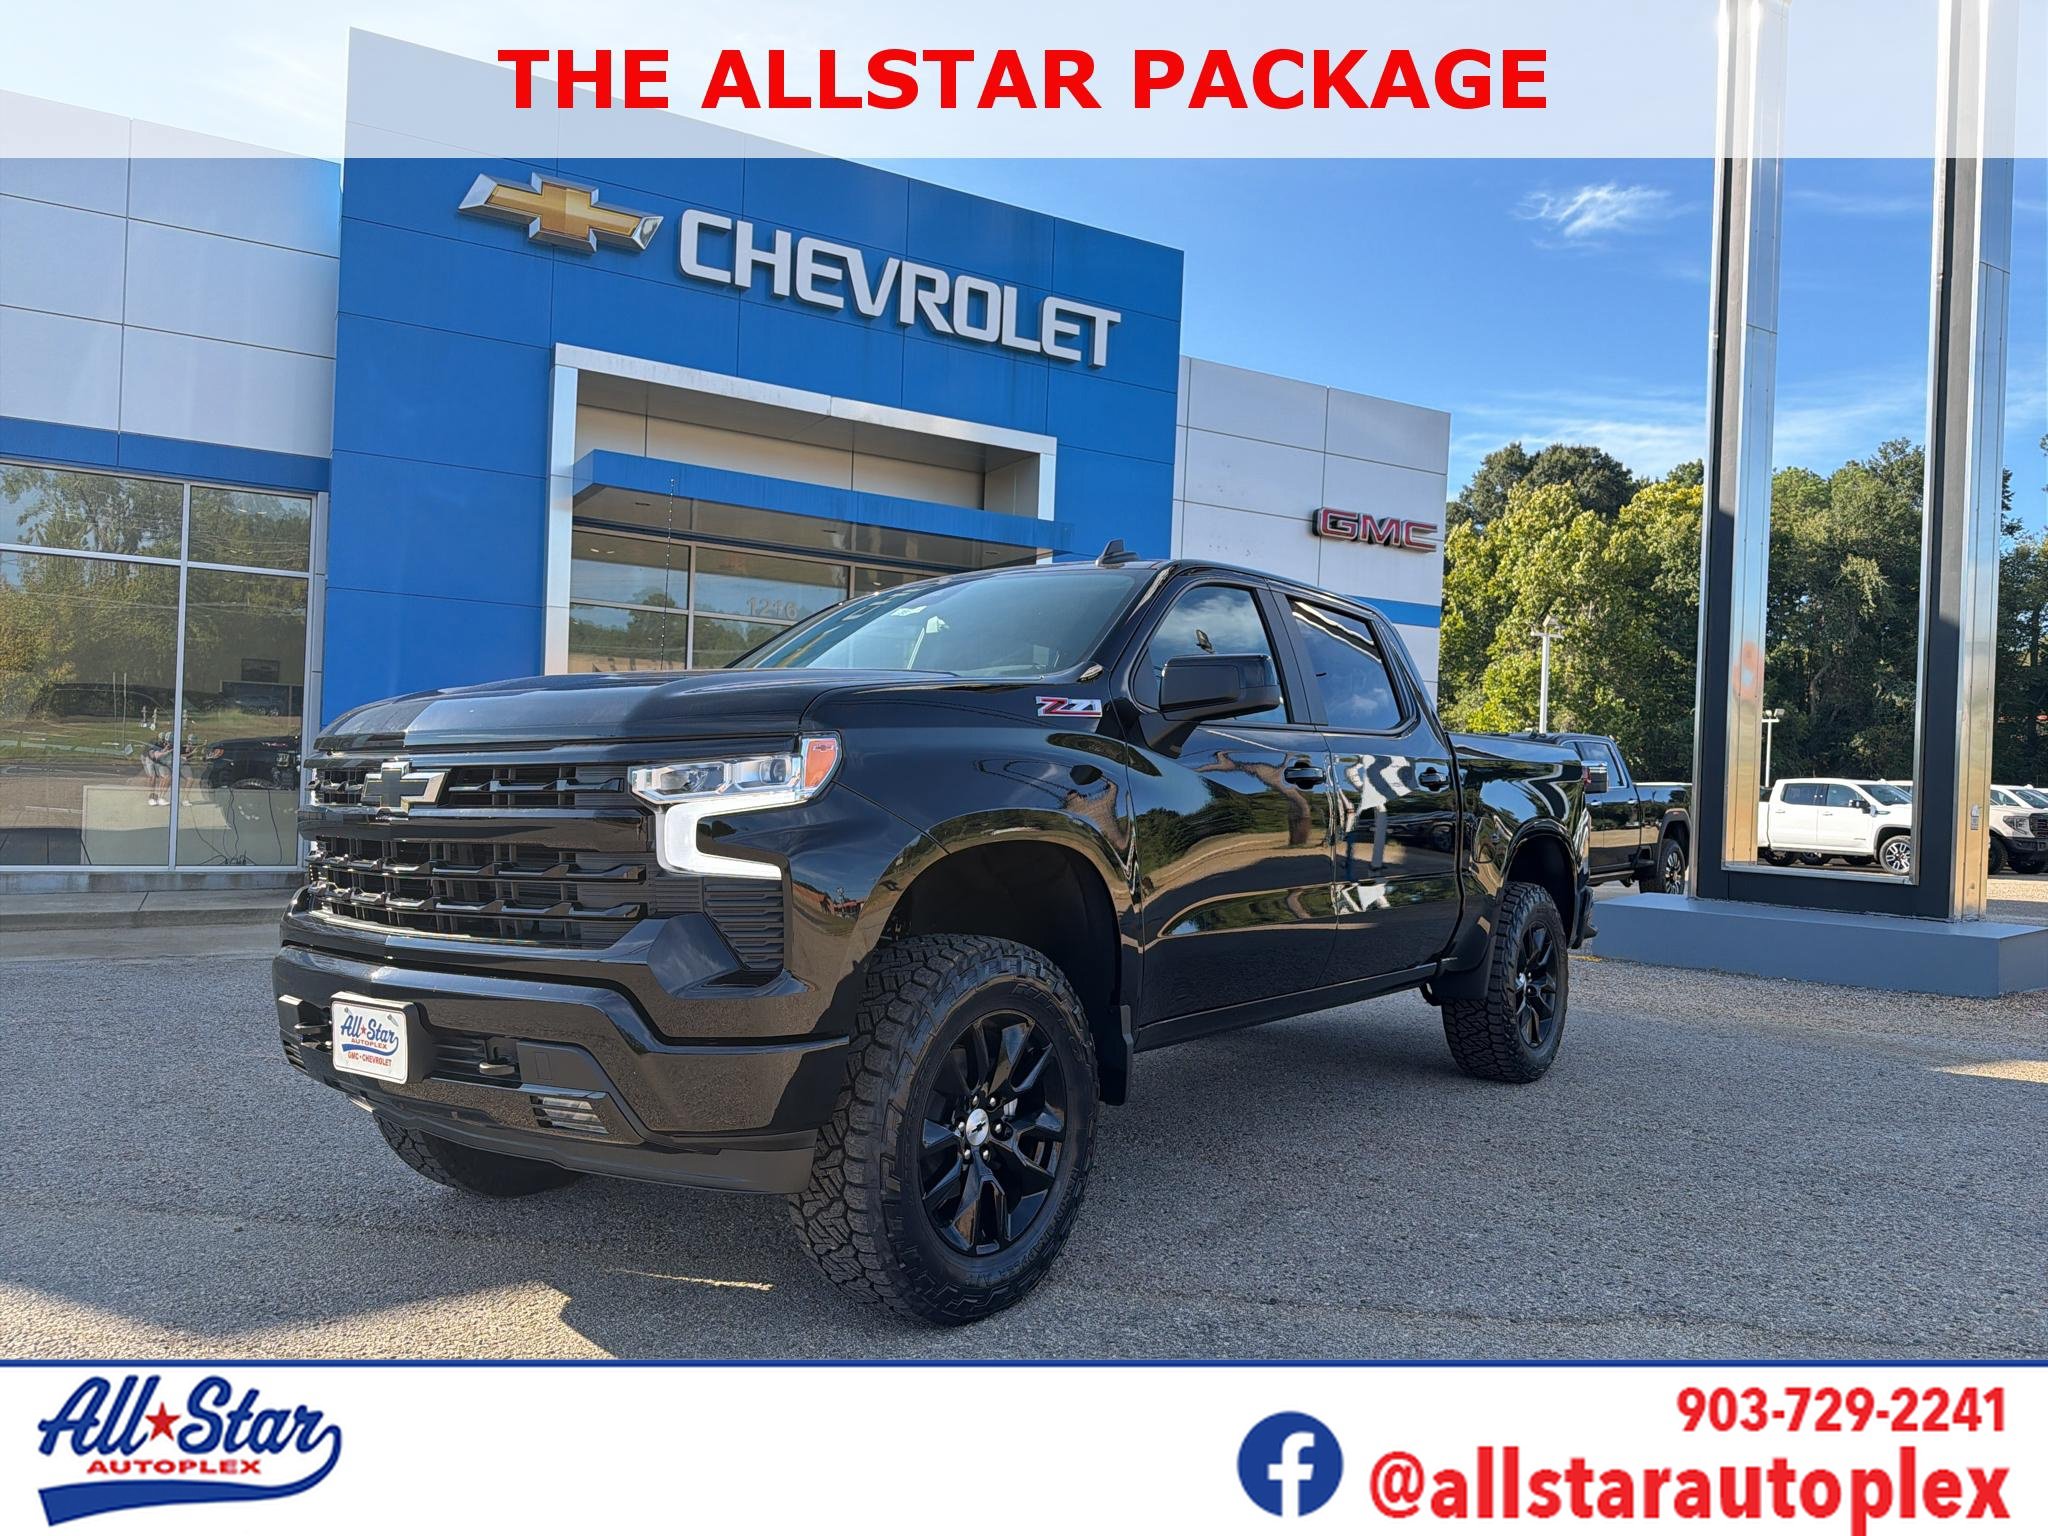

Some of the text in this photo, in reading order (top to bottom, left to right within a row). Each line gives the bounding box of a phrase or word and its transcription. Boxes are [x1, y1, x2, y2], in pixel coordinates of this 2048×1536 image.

[679, 208, 1122, 368] CHEVROLET
[1313, 507, 1438, 552] GMC
[746, 597, 798, 620] 1216
[1036, 696, 1103, 717] Z71
[351, 1037, 388, 1050] AUTOPLEX
